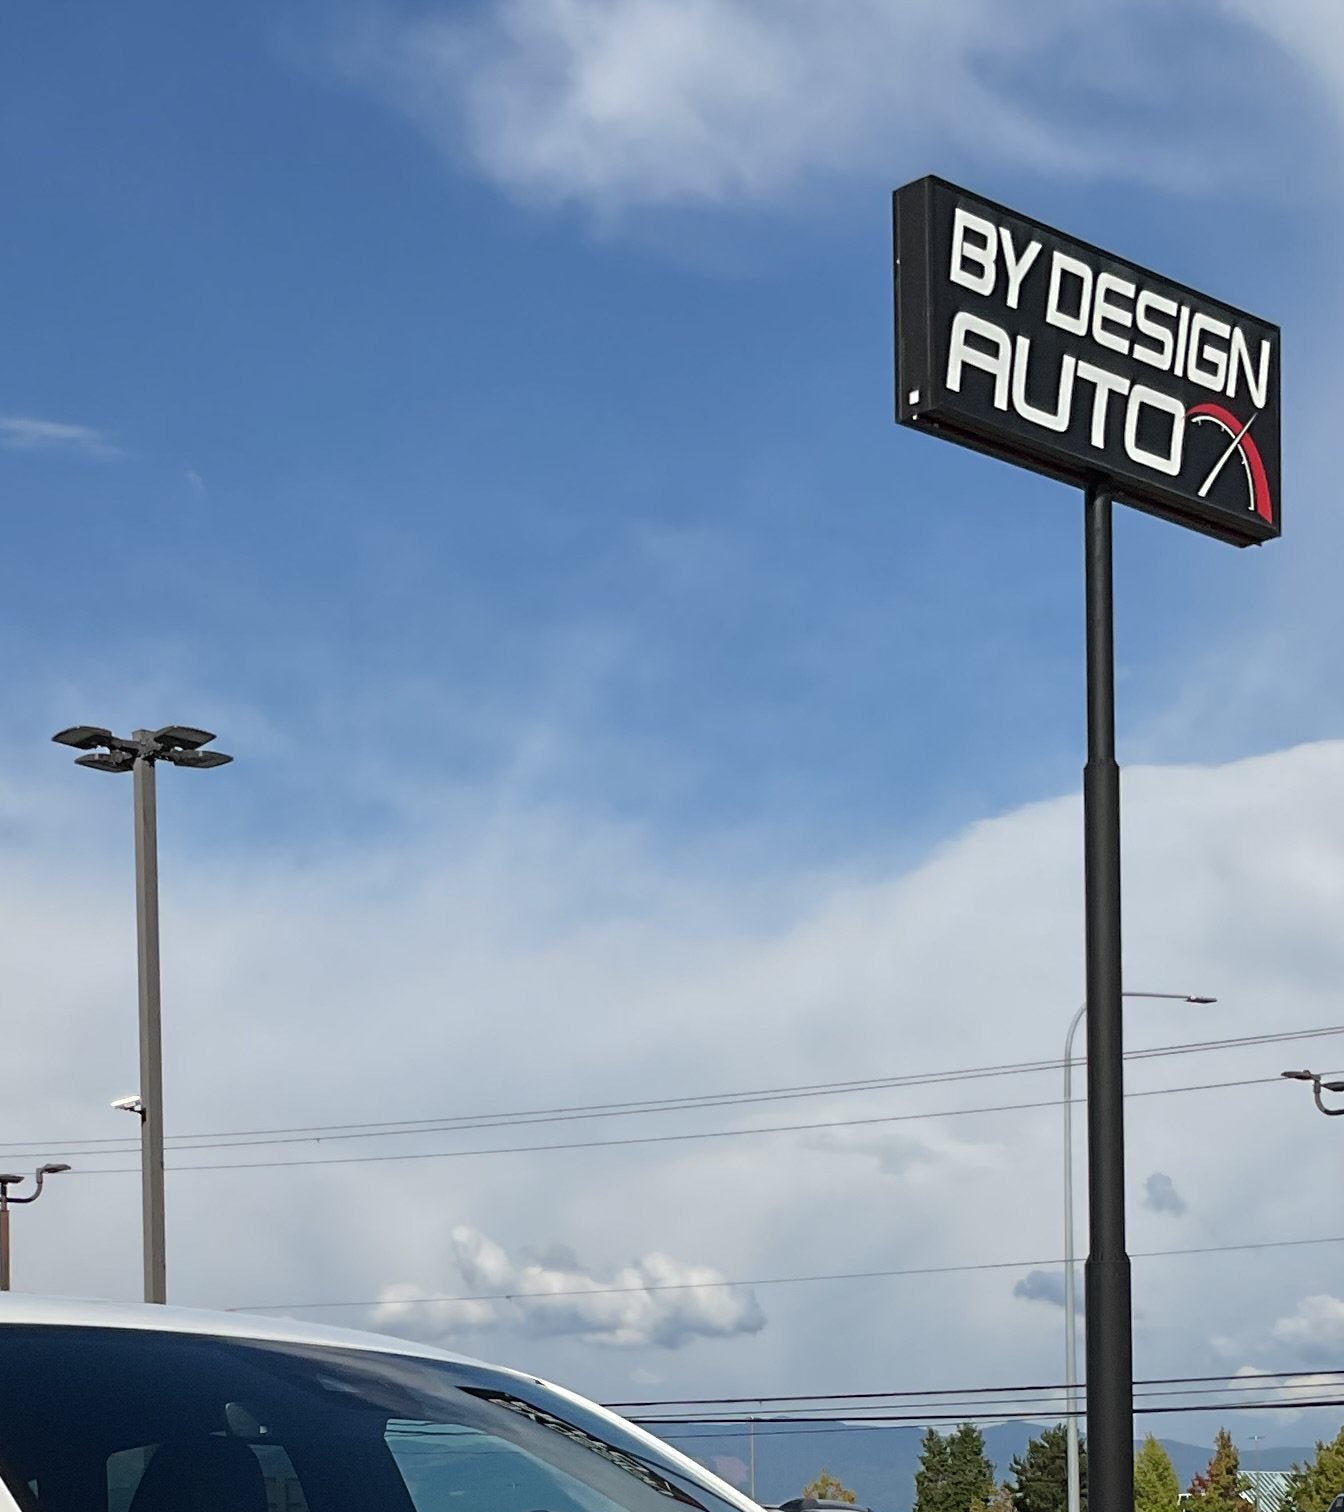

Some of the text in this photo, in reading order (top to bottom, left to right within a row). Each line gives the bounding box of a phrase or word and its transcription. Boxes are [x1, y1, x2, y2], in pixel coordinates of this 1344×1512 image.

[946, 311, 1185, 477] AUTO
[950, 207, 1271, 409] BY DESIGN
